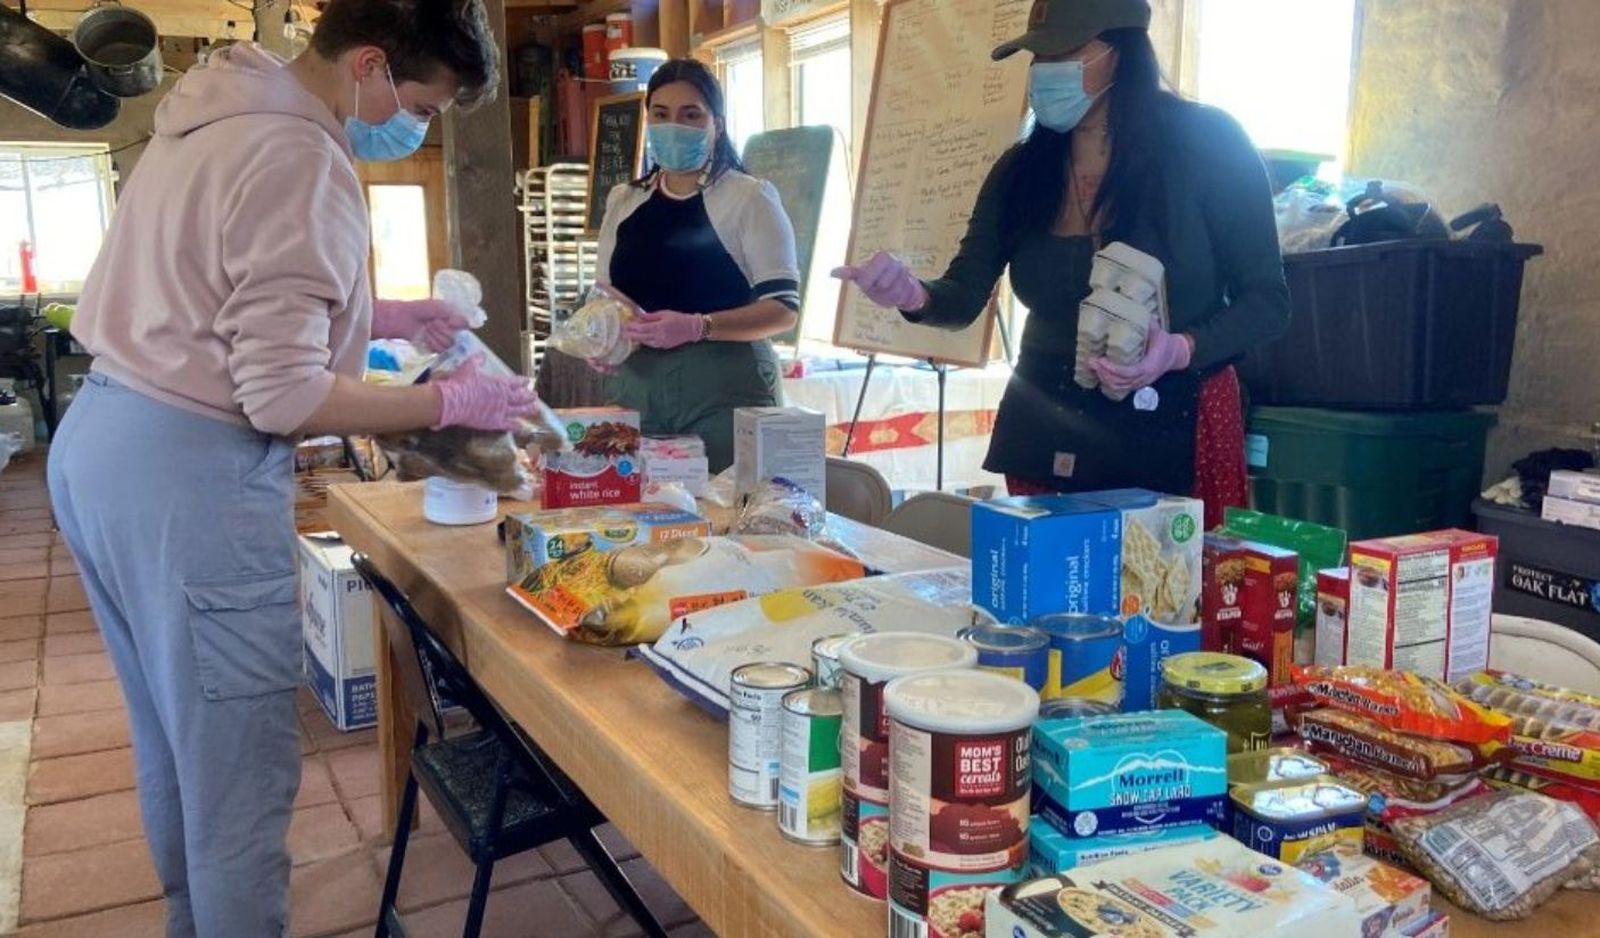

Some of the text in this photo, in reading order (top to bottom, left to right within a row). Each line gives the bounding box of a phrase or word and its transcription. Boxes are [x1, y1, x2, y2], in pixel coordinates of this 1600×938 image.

[570, 489, 620, 500] white rice
[989, 548, 1000, 609] original
[1512, 564, 1553, 582] PROTECT
[1065, 555, 1081, 616] original
[1512, 573, 1589, 606] OAK FLAT
[1308, 723, 1372, 757] Maruchan
[1531, 740, 1580, 761] Creme
[960, 745, 1002, 758] MOM'S
[960, 757, 1002, 773] BEST
[960, 770, 1002, 785] cereals
[1120, 767, 1184, 787] Morrell
[1111, 790, 1139, 806] SNOW
[1165, 782, 1191, 800] LARD
[1168, 869, 1263, 914] VARIETY
